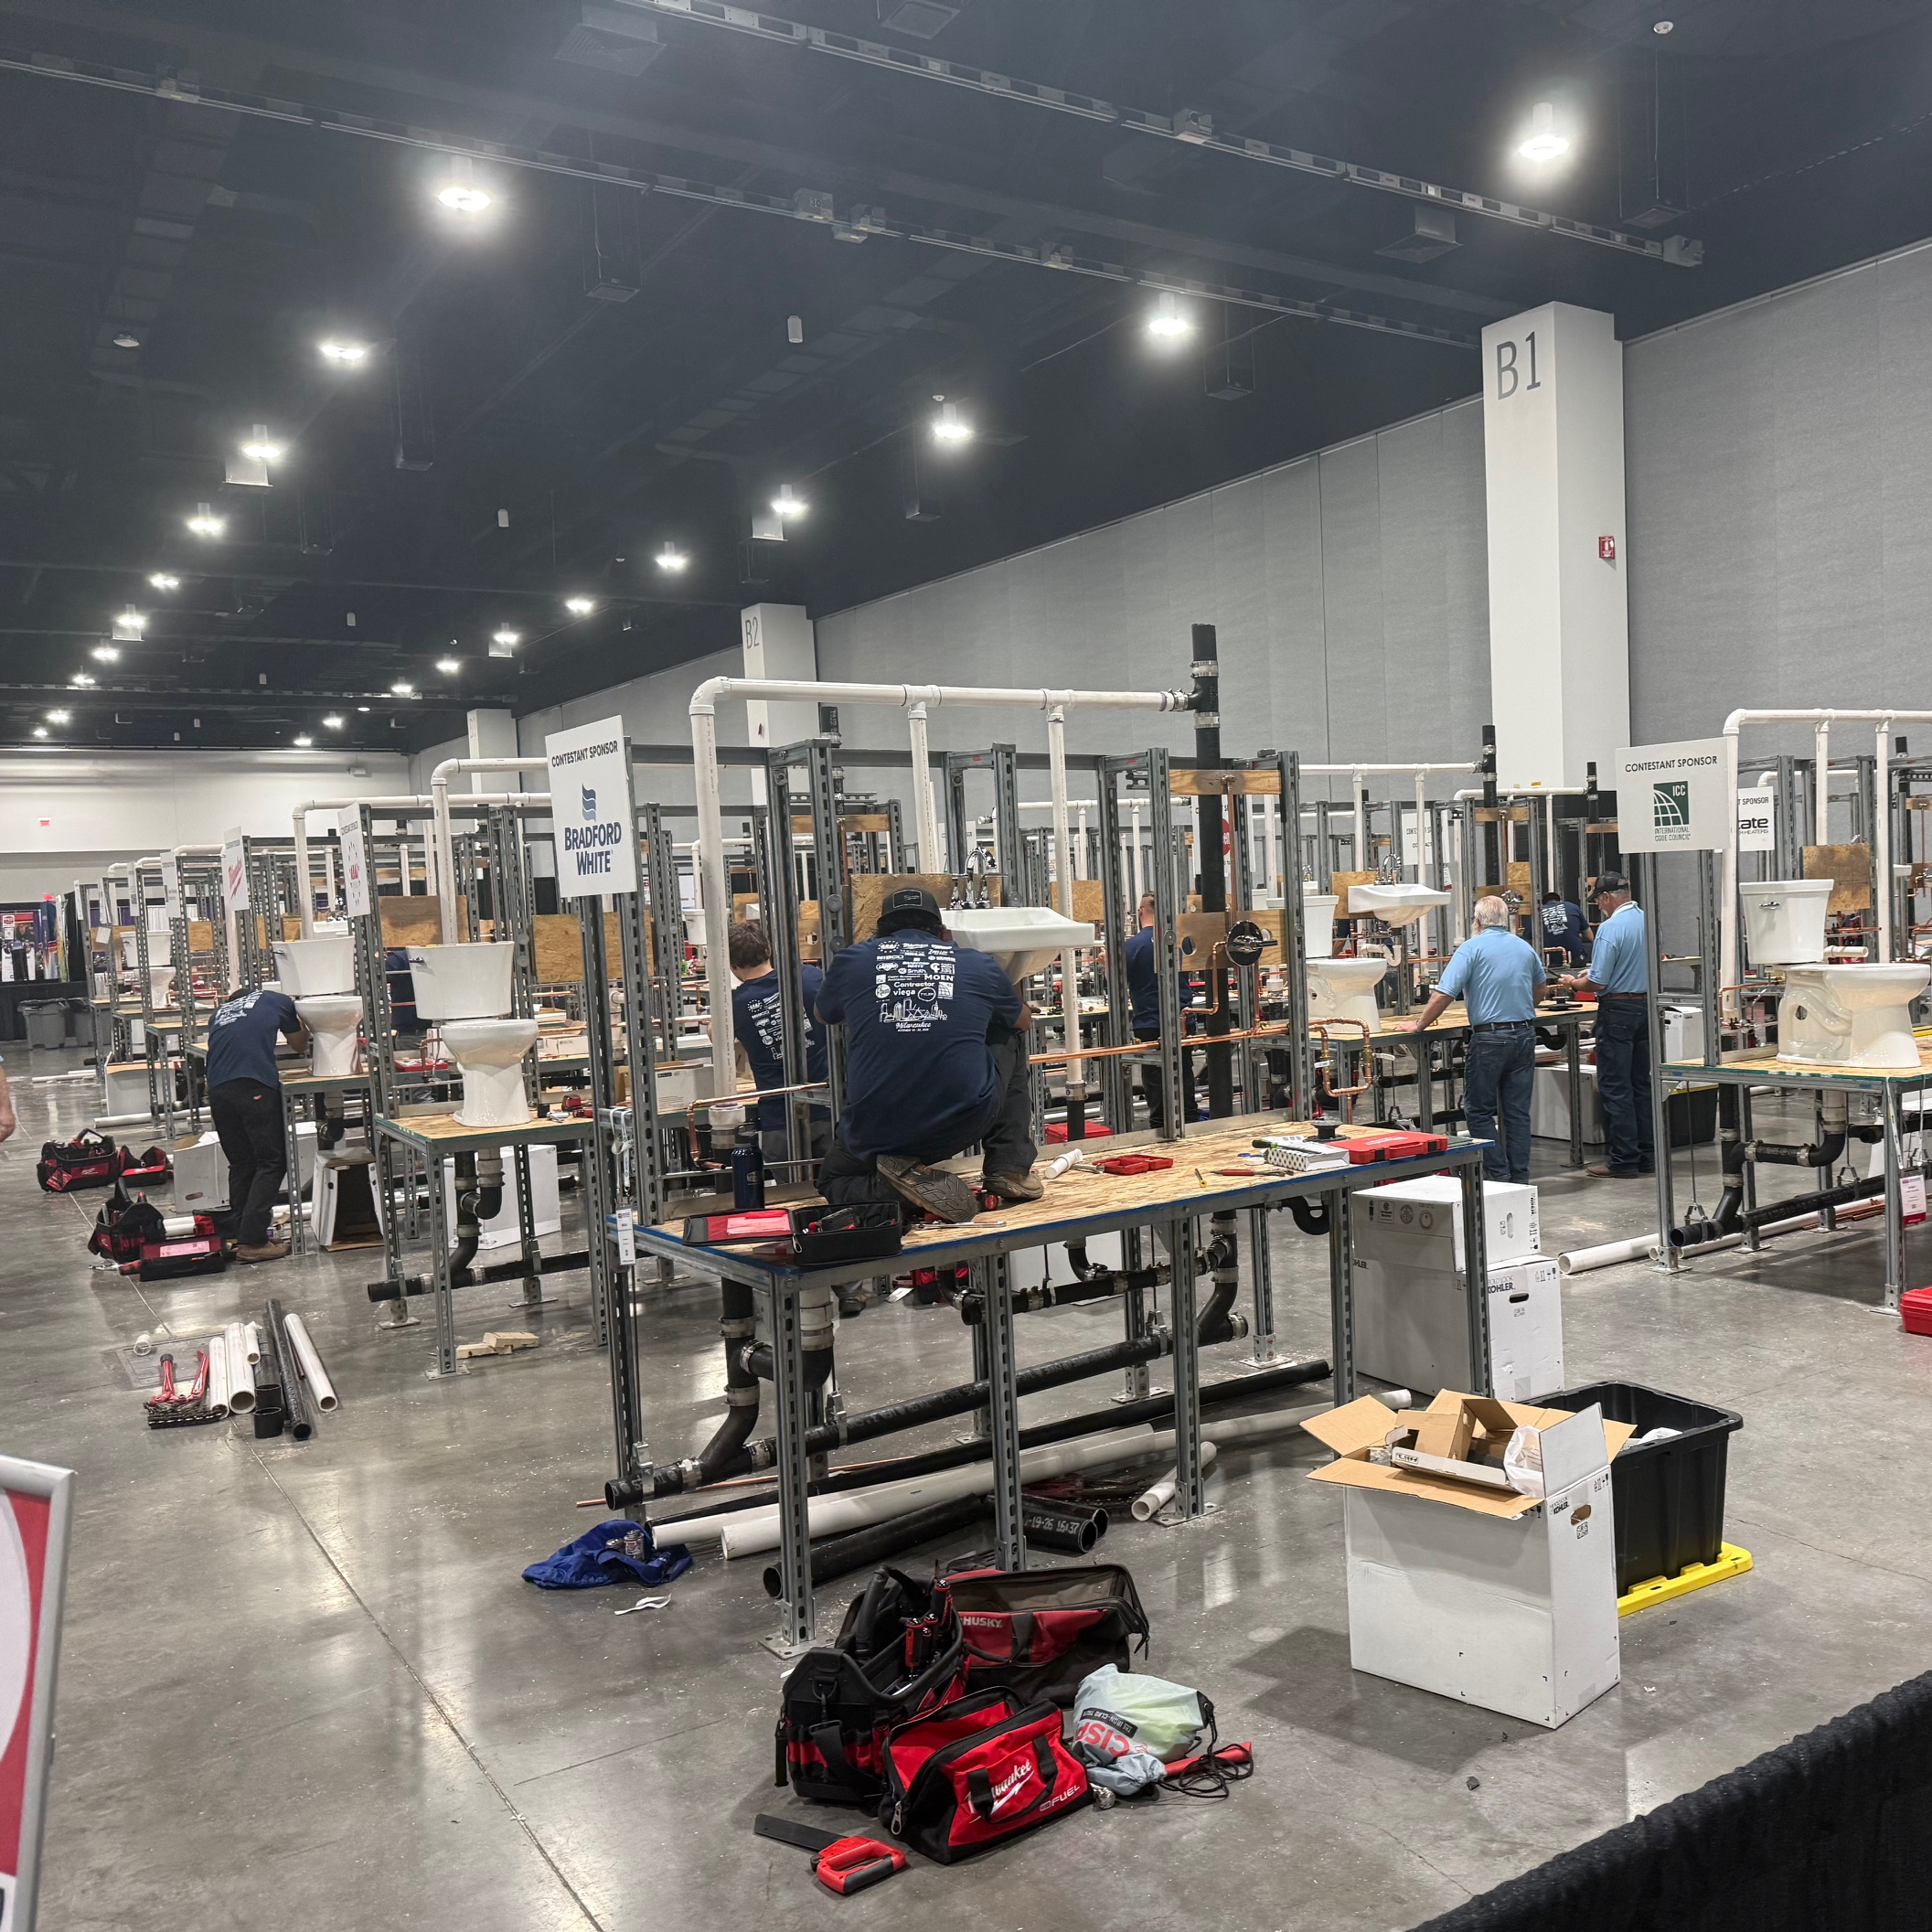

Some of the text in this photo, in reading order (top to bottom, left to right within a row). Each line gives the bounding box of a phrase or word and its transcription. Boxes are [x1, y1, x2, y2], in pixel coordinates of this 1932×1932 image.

[1497, 331, 1541, 400] B1
[745, 616, 760, 649] B2
[551, 740, 618, 767] CONTESTANT SPONSOR
[1625, 756, 1717, 772] CONTESTANT SPONSOR
[1672, 785, 1685, 796] ICC
[1742, 796, 1769, 806] SPONSOR
[1655, 827, 1690, 835] INTERNATIONAL
[1739, 817, 1768, 829] ate
[564, 822, 622, 851] BRADFORD
[1669, 833, 1690, 841] COUNCIL
[576, 850, 611, 876] WHITE
[924, 974, 954, 982] MOEN
[892, 987, 916, 997] viega
[1094, 1711, 1124, 1729] IRON-CLAD
[1076, 1722, 1130, 1757] CISP
[1051, 1785, 1080, 1806] FUEL
